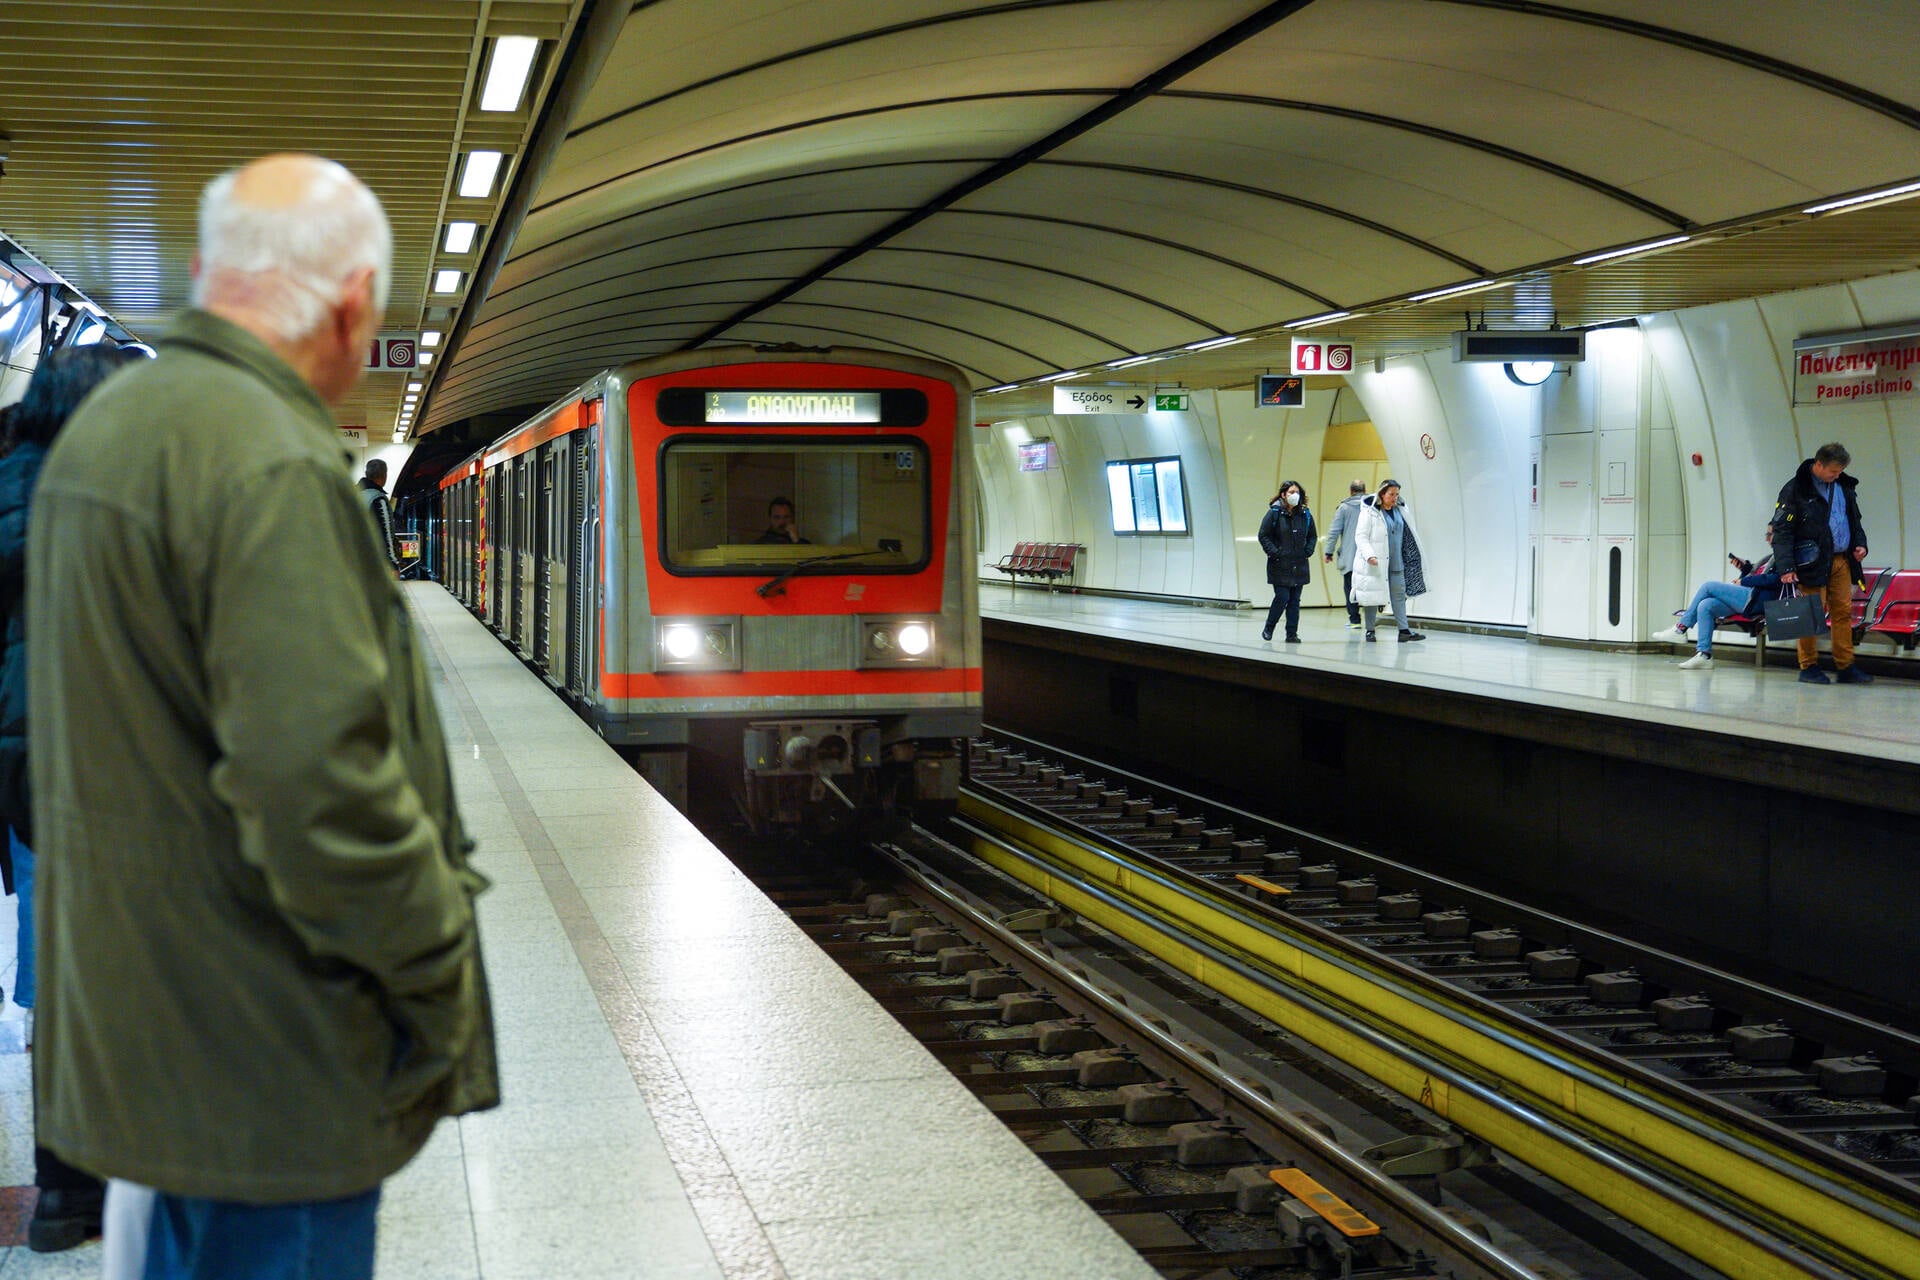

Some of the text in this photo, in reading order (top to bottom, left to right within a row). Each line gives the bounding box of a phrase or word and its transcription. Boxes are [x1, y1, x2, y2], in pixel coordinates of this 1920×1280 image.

[1817, 377, 1912, 399] Panepistimio
[712, 393, 720, 407] 2
[1070, 392, 1113, 404] Έξοδος
[1085, 405, 1100, 413] Exit
